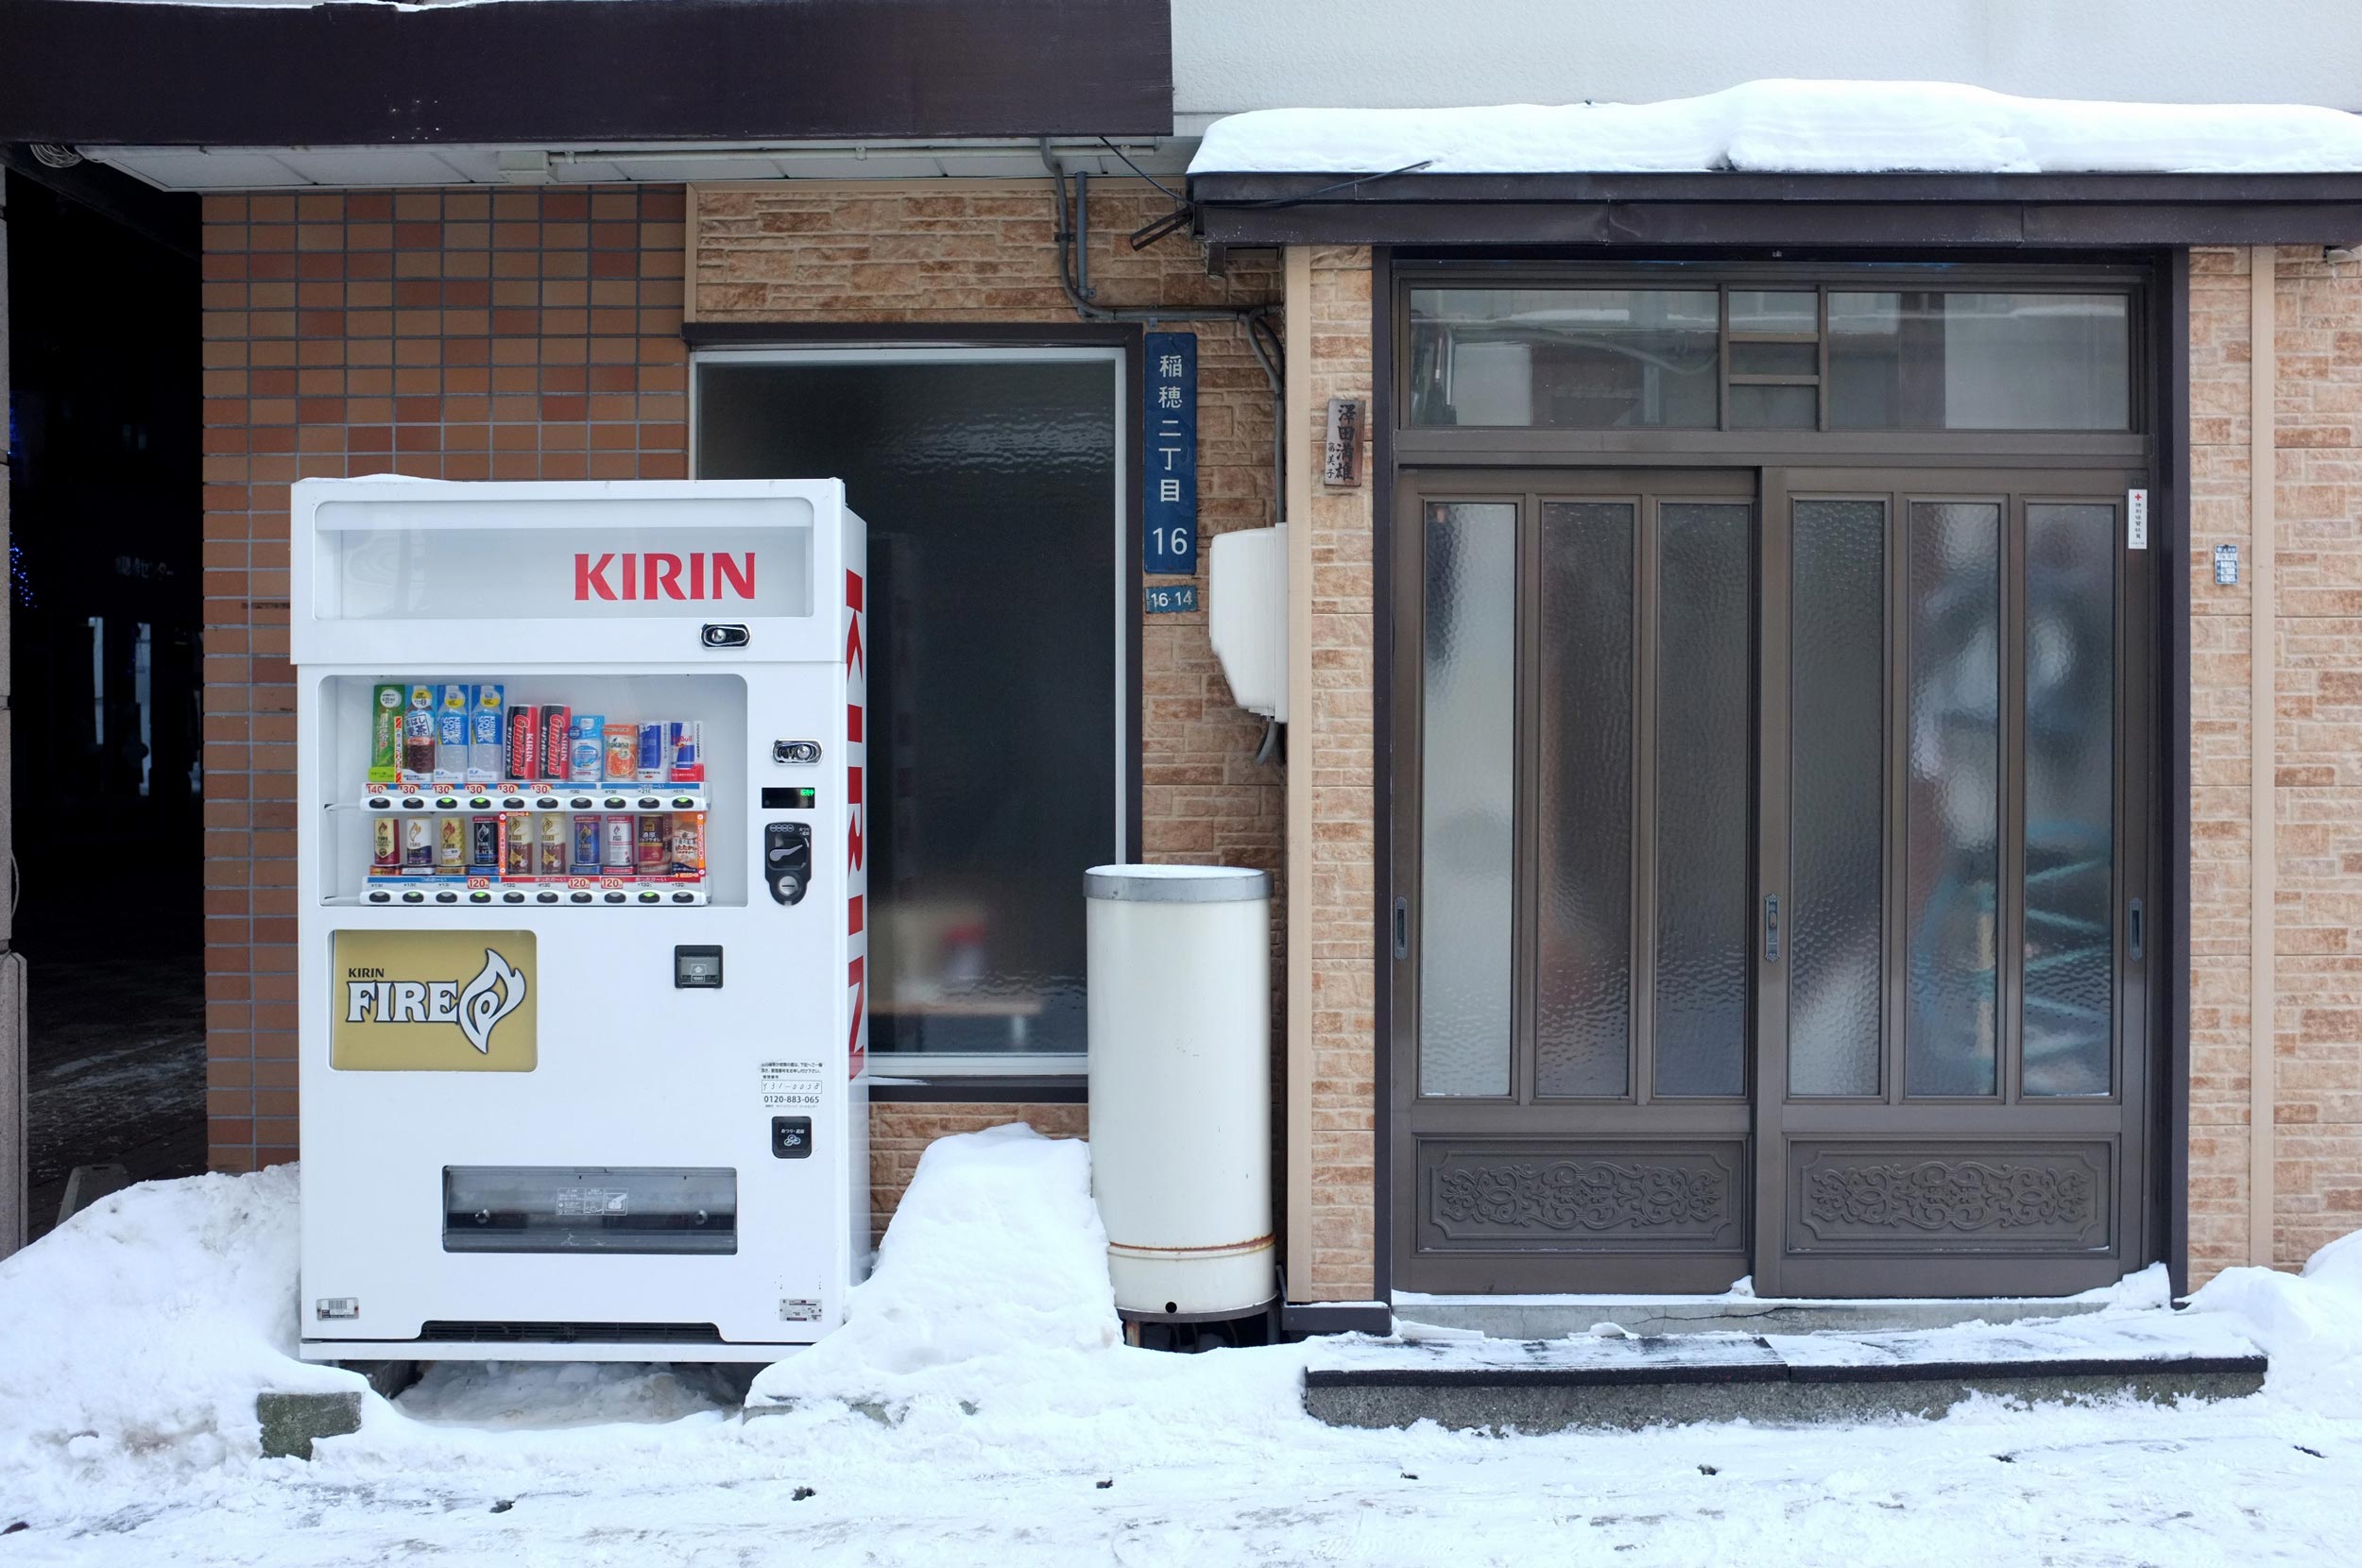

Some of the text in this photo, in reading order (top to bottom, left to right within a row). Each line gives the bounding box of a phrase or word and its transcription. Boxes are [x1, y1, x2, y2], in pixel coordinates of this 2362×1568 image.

[1152, 354, 1189, 555] 稲穂二丁目 16
[574, 553, 756, 601] KIRIN
[525, 733, 534, 762] KIRIN
[846, 568, 864, 1082] KIRIN
[469, 879, 486, 888] 120
[570, 879, 586, 888] 120
[603, 879, 619, 888] 120
[348, 967, 385, 978] KIRIN
[345, 980, 459, 1025] FIRE
